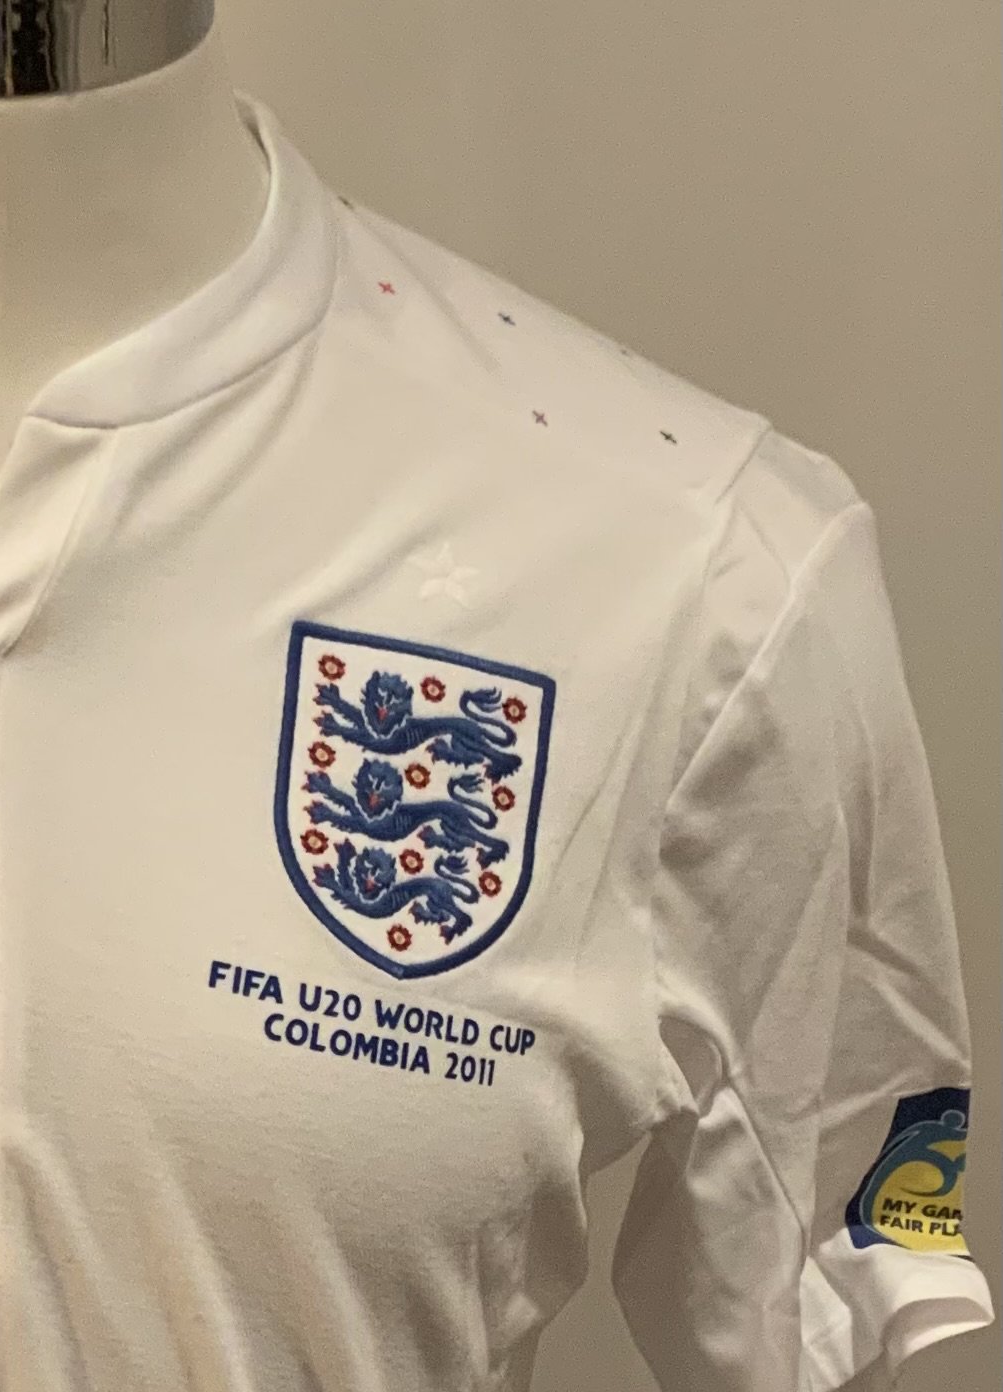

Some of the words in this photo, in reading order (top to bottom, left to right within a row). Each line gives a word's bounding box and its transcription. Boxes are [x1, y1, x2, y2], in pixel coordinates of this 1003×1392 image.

[208, 960, 284, 1004] FIFA
[299, 983, 362, 1021] U20
[374, 999, 480, 1046] WORLD
[489, 1025, 536, 1056] CUP
[264, 1013, 430, 1074] COLOMBIA
[444, 1052, 496, 1086] 2011
[879, 1215, 923, 1233] FAIR
[882, 1198, 917, 1213] MY
